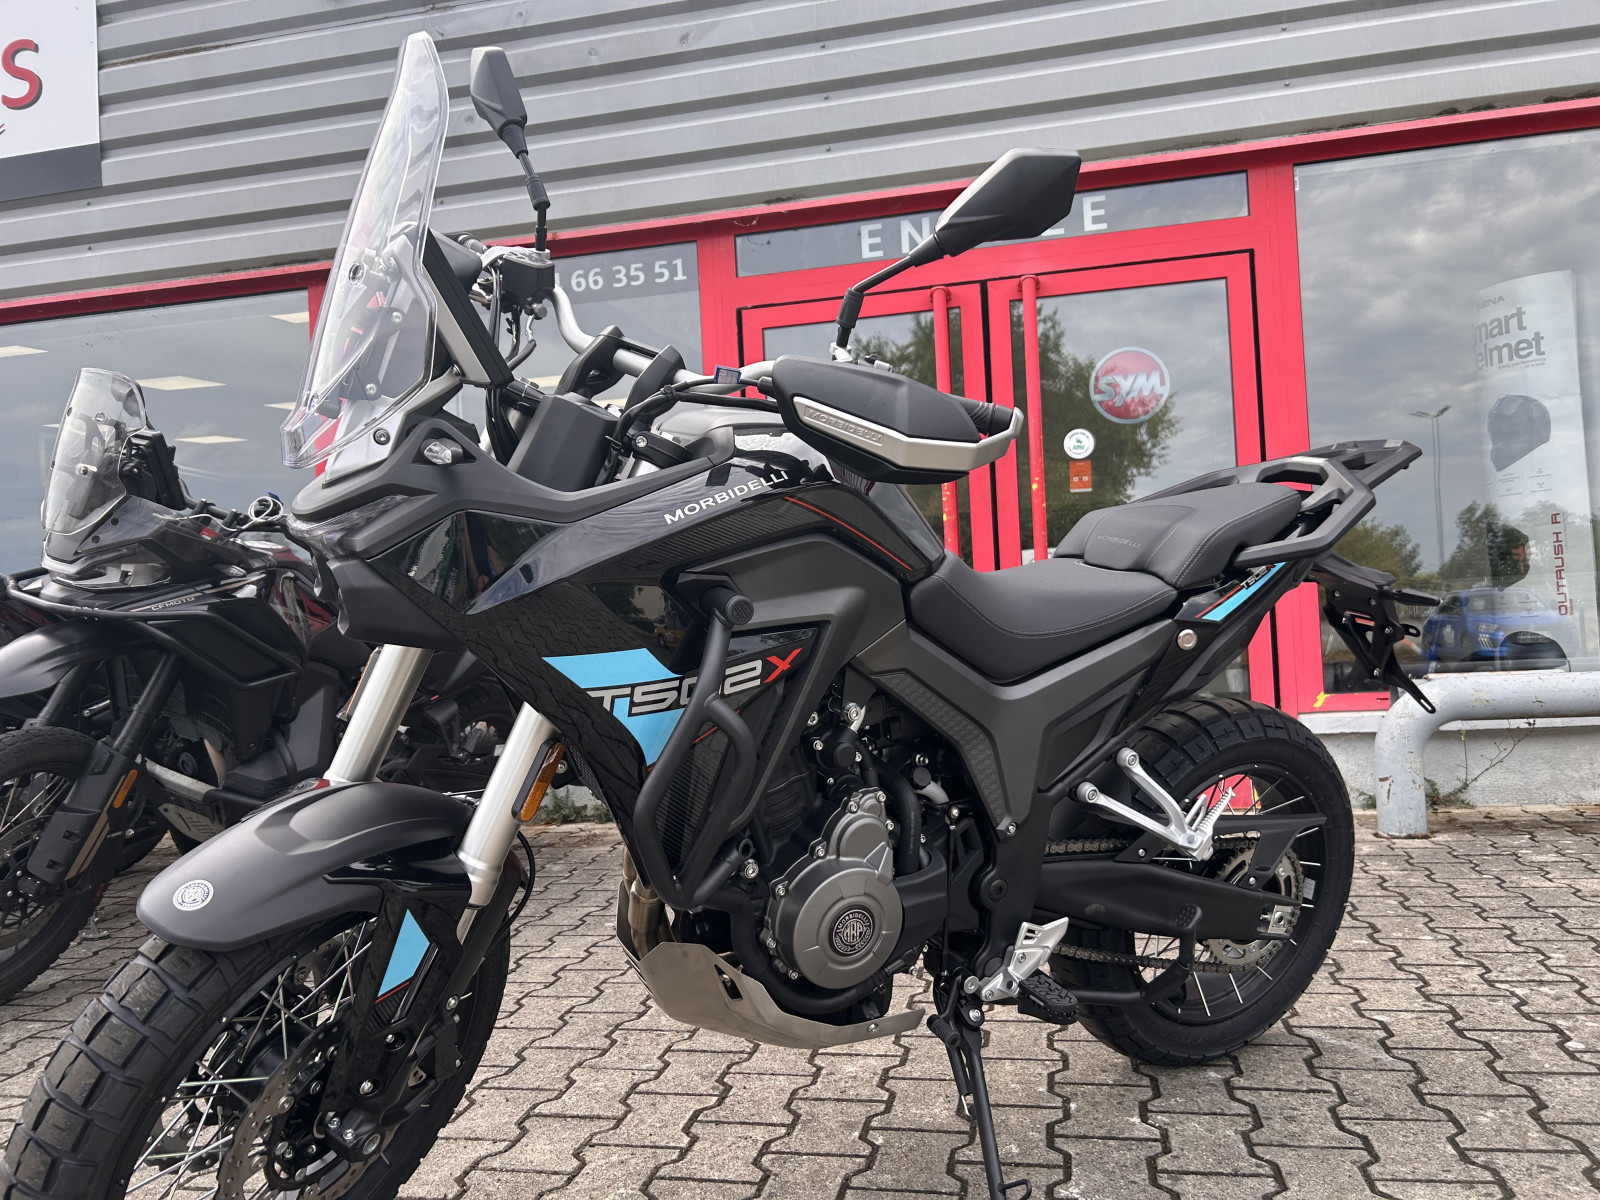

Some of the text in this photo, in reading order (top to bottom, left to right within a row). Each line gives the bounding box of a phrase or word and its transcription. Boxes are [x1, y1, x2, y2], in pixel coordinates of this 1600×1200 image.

[860, 194, 1109, 260] ENE
[570, 269, 604, 292] 66
[612, 262, 645, 288] 35
[654, 258, 688, 283] 51
[1472, 306, 1528, 344] mart
[1474, 331, 1546, 371] elmet
[1093, 369, 1167, 408] SYM
[809, 409, 884, 443] MORBIDELLI
[663, 470, 789, 525] MORBIDELLI
[1098, 535, 1142, 548] MORBIDELLI
[151, 596, 195, 611] CFMOTO
